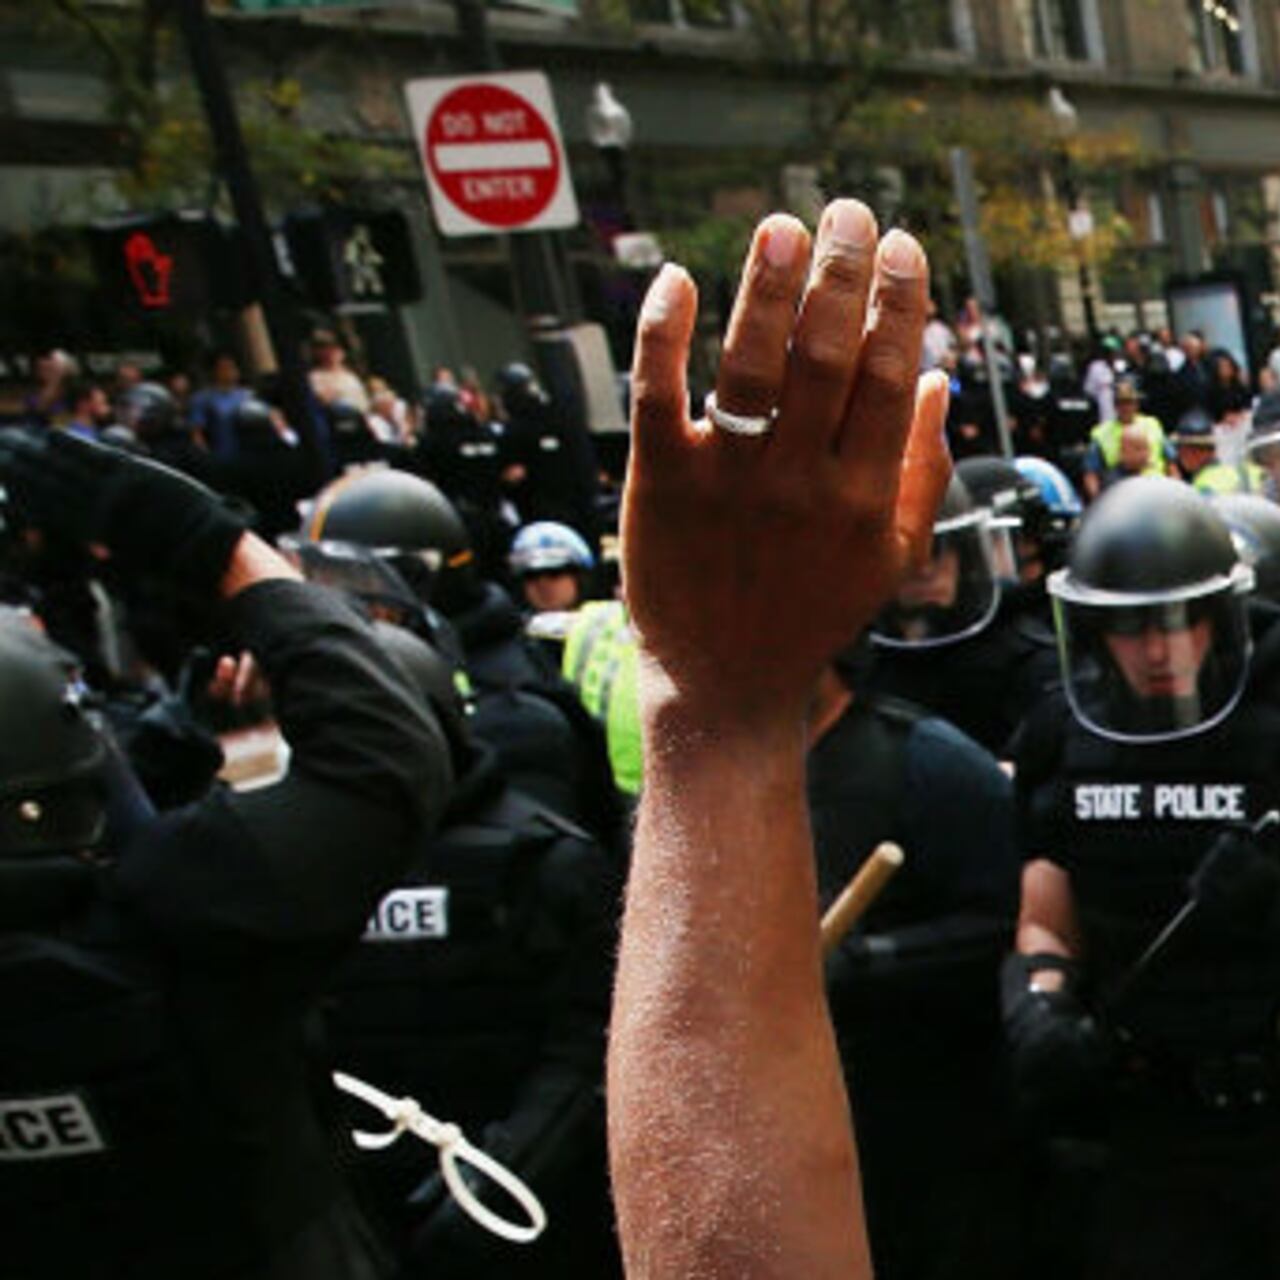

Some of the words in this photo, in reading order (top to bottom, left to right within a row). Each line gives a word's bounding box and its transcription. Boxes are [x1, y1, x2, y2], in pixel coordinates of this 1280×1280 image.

[441, 110, 477, 138] DO
[481, 108, 527, 135] NOT
[462, 176, 536, 202] ENTER
[1075, 784, 1142, 820] STATE
[1154, 784, 1246, 820] POLICE
